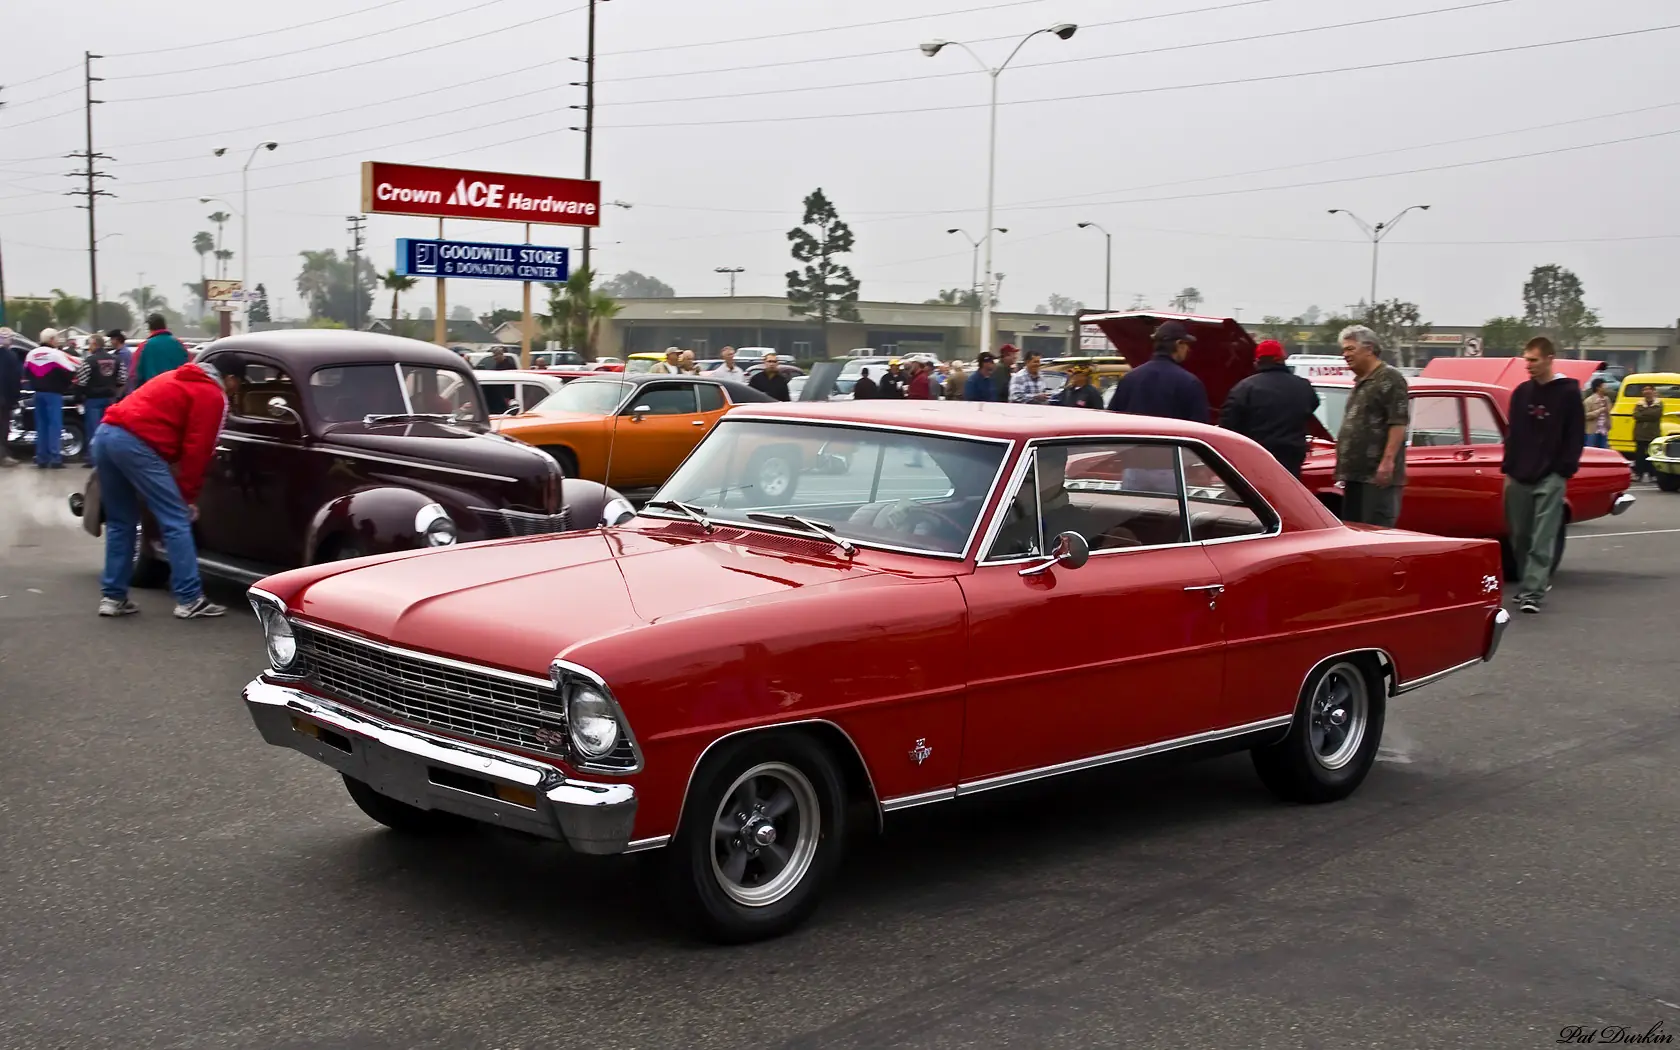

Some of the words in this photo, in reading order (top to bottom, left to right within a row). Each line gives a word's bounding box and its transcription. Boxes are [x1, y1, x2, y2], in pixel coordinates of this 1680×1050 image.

[377, 183, 441, 204] Crown
[446, 177, 505, 208] ACE
[507, 192, 596, 216] Hardware
[440, 244, 515, 262] GOODWILL
[520, 249, 563, 264] STORE
[444, 262, 454, 273] &
[456, 262, 514, 276] DONATION
[517, 265, 558, 278] CENTER
[535, 727, 563, 746] SS
